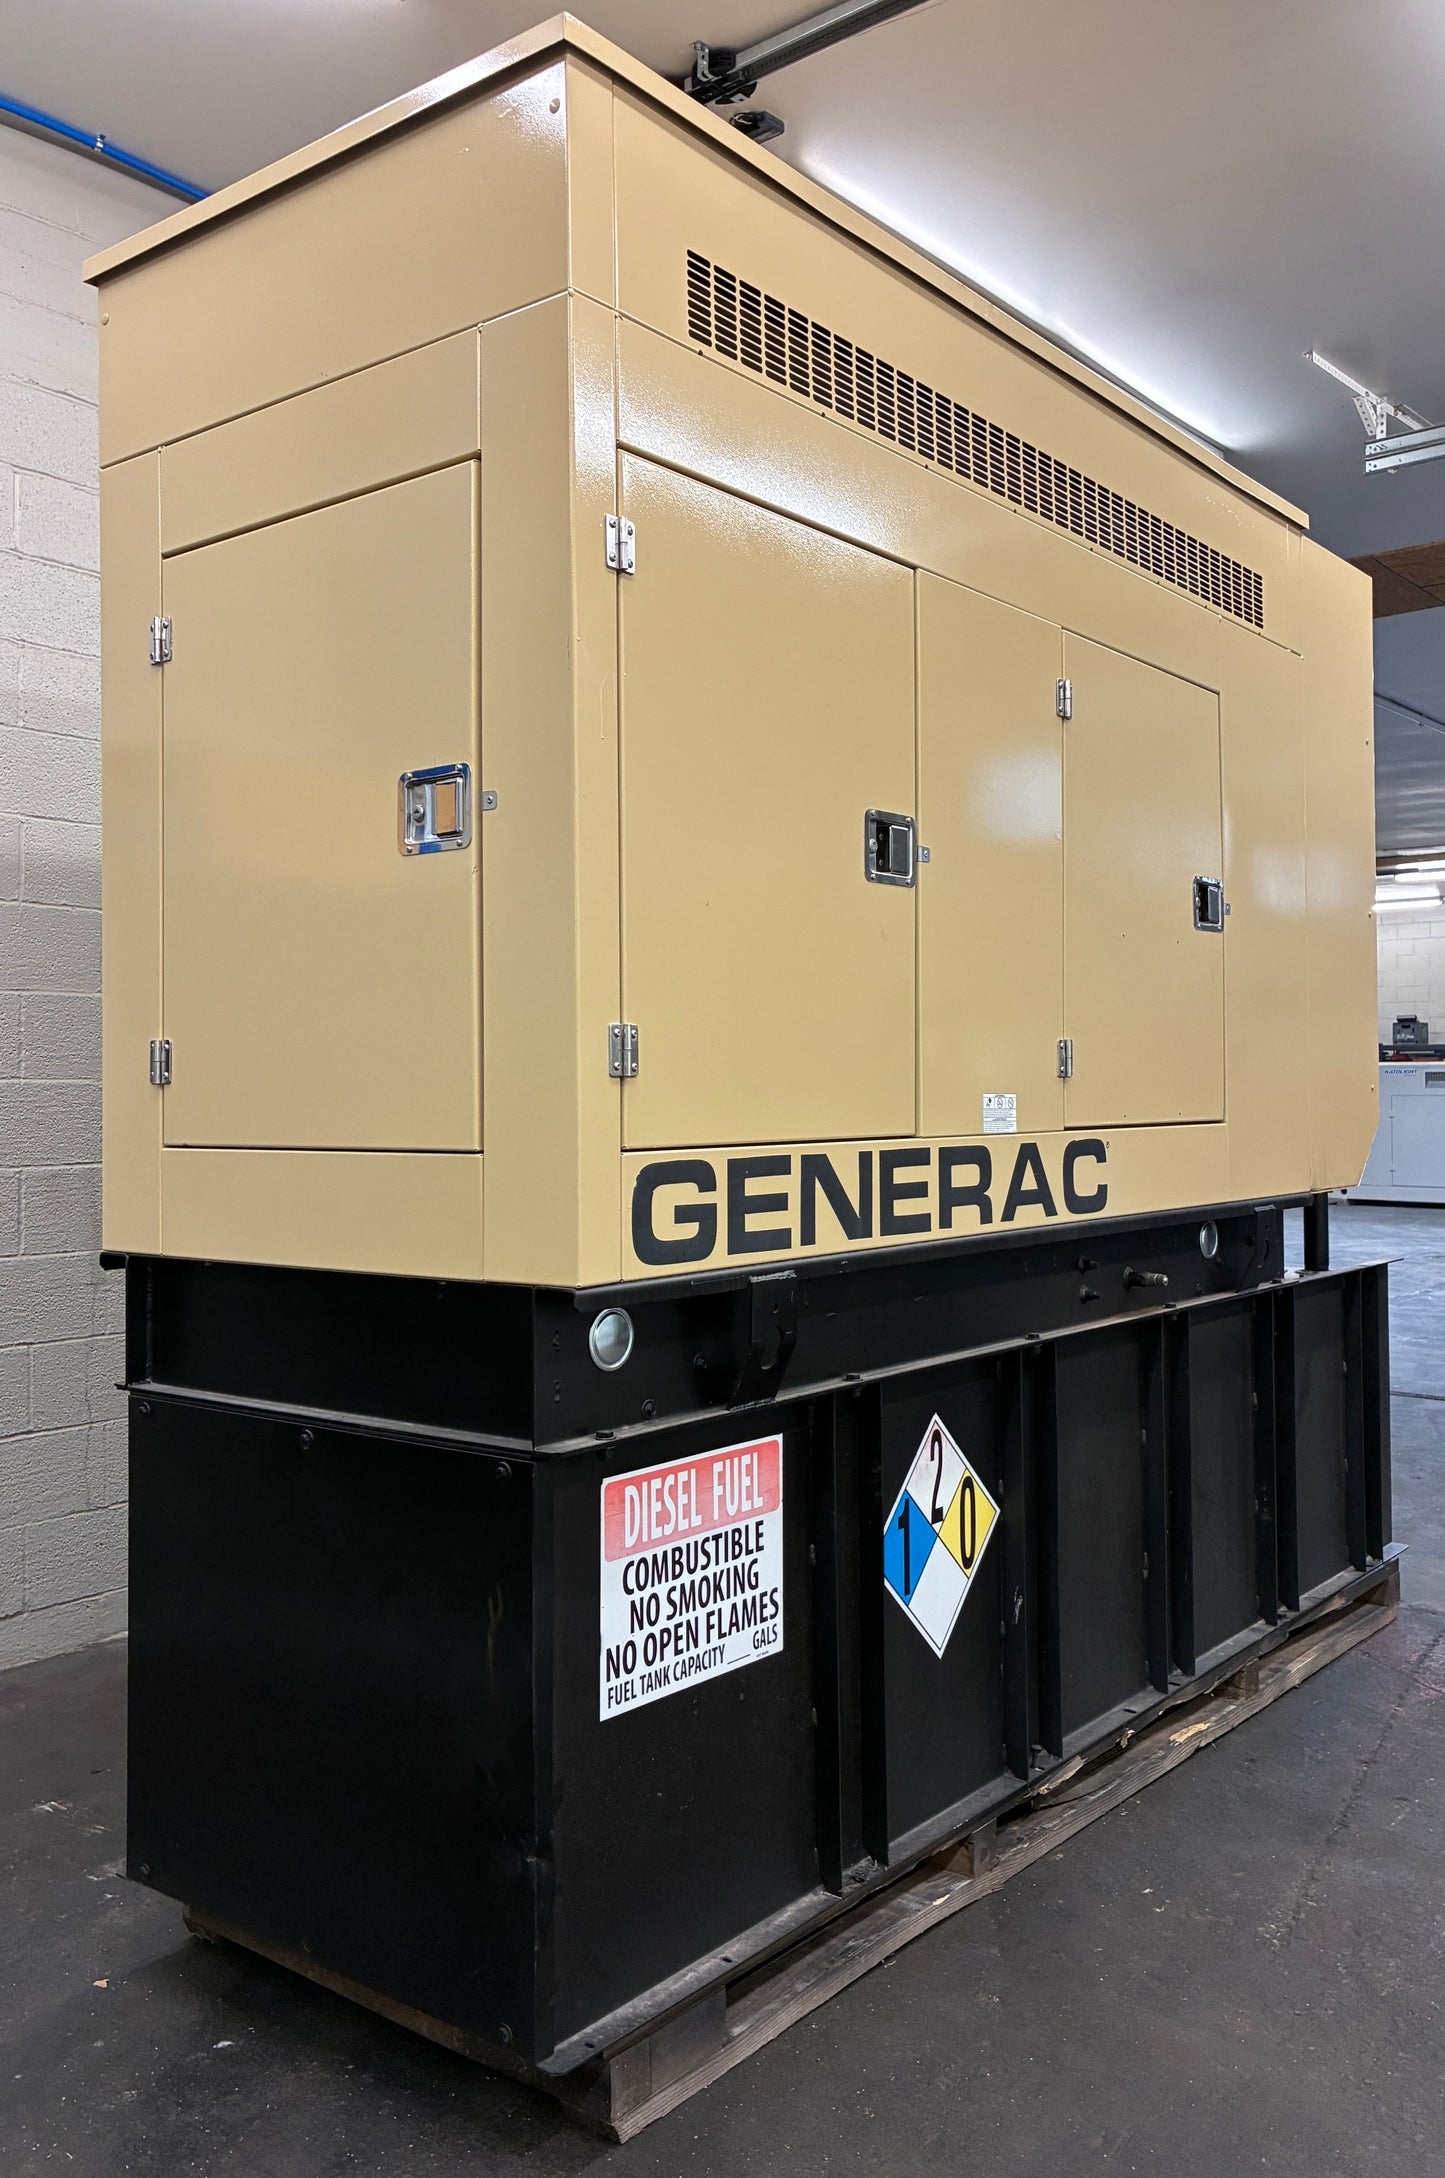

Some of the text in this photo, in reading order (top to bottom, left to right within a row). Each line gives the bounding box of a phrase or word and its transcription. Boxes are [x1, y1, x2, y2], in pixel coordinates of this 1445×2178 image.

[632, 1138, 1108, 1266] GENERAC
[624, 1451, 764, 1548] DIESEL FUEL
[930, 1429, 944, 1524] 2
[622, 1519, 765, 1596] COMBUSTIBLE
[898, 1475, 976, 1596] 1 0
[606, 1587, 780, 1683] NO OPEN FLAMES
[630, 1558, 760, 1634] NO SMOKING
[607, 1624, 778, 1709] FUEL TANK CAPACITY GALS
